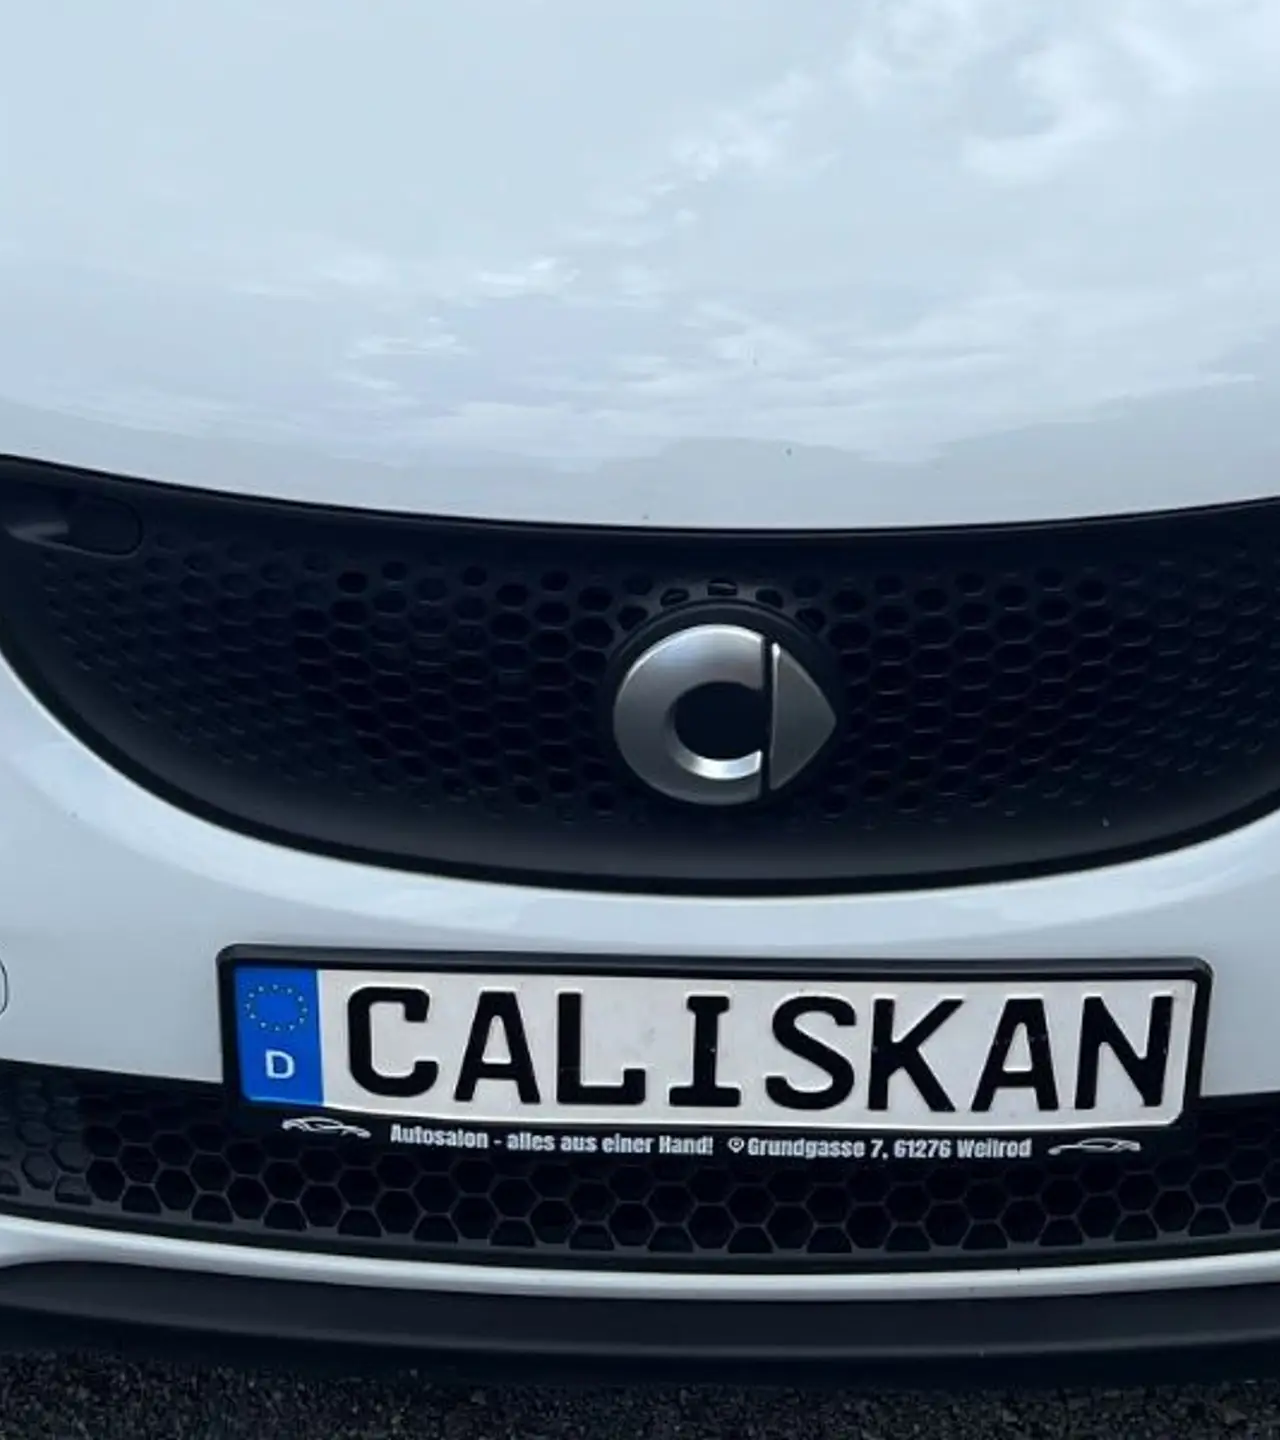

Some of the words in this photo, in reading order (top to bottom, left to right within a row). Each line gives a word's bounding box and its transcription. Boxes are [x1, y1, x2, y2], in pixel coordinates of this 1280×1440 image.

[265, 1049, 296, 1080] D
[347, 984, 1173, 1113] CALISKAN
[390, 1123, 489, 1149] Autosalon
[506, 1132, 555, 1152] alles
[560, 1135, 598, 1152] aus
[601, 1133, 654, 1154] einer
[659, 1135, 713, 1156] Hand!
[747, 1137, 866, 1159] Grundgasse
[894, 1139, 952, 1158] 61276
